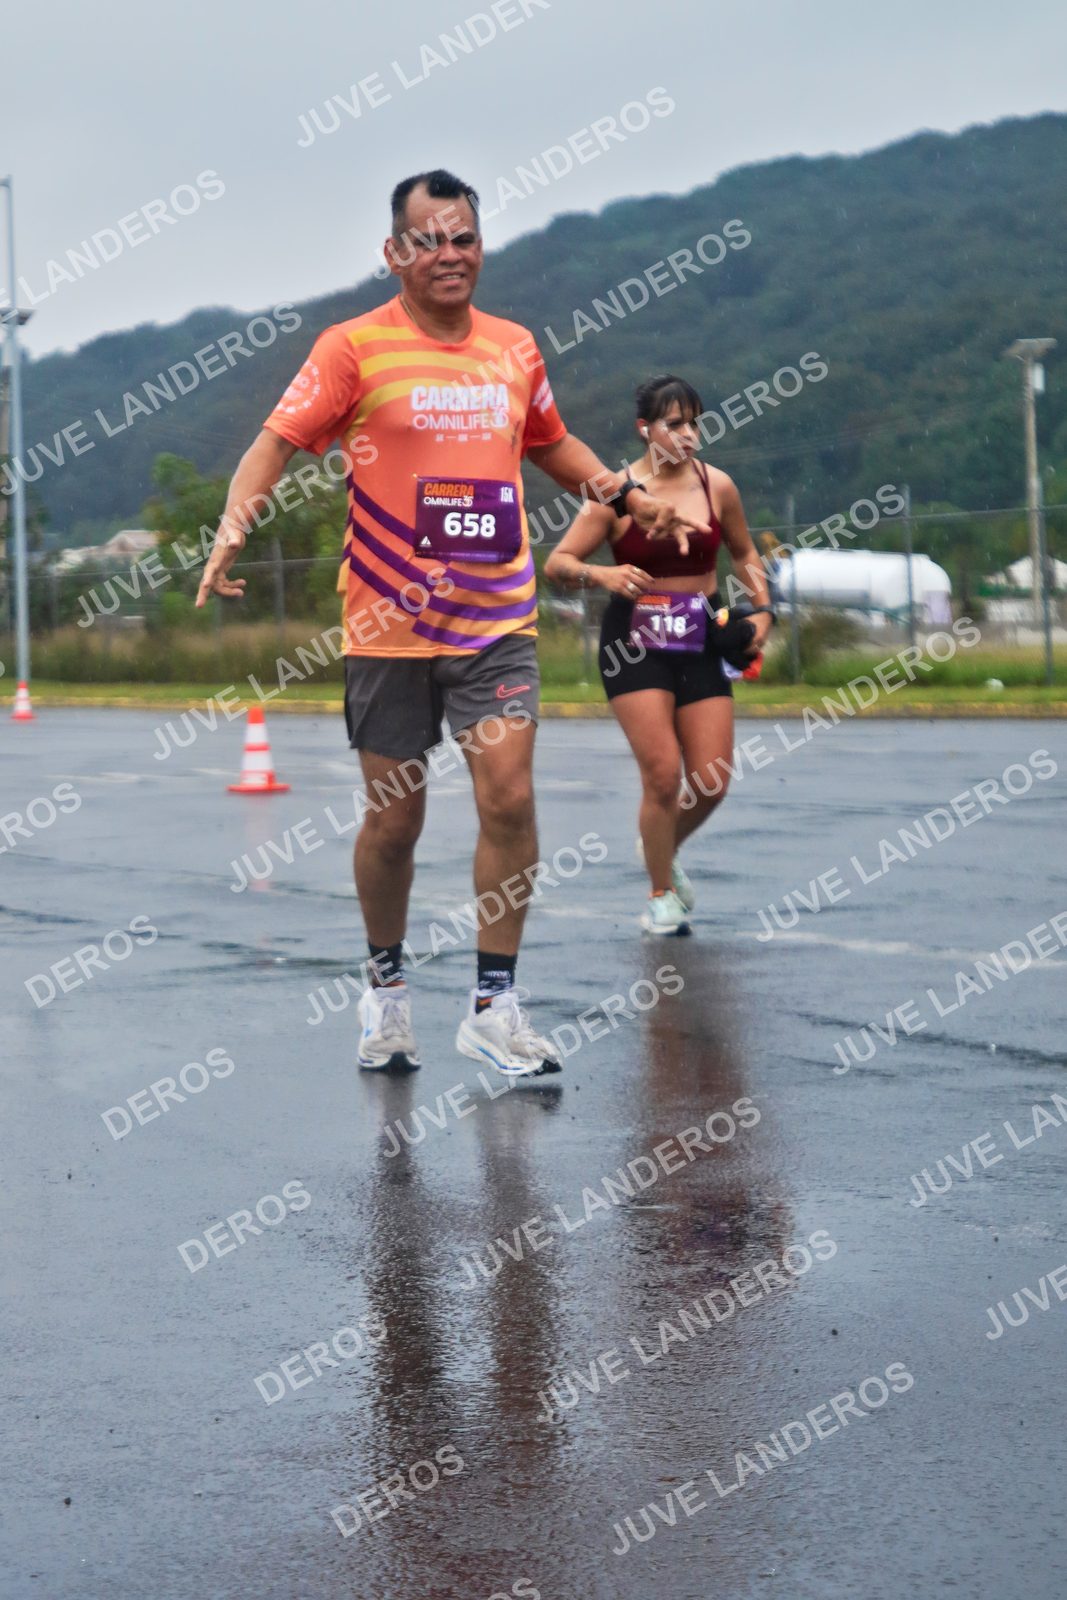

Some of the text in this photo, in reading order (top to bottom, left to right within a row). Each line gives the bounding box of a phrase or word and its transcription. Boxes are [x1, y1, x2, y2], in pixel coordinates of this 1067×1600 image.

[411, 384, 509, 411] CARRERA
[413, 413, 489, 430] OMNILIFE
[423, 482, 475, 497] CARRERA
[423, 496, 463, 507] OMNILIFE
[444, 512, 497, 538] 658
[650, 615, 687, 634] 118
